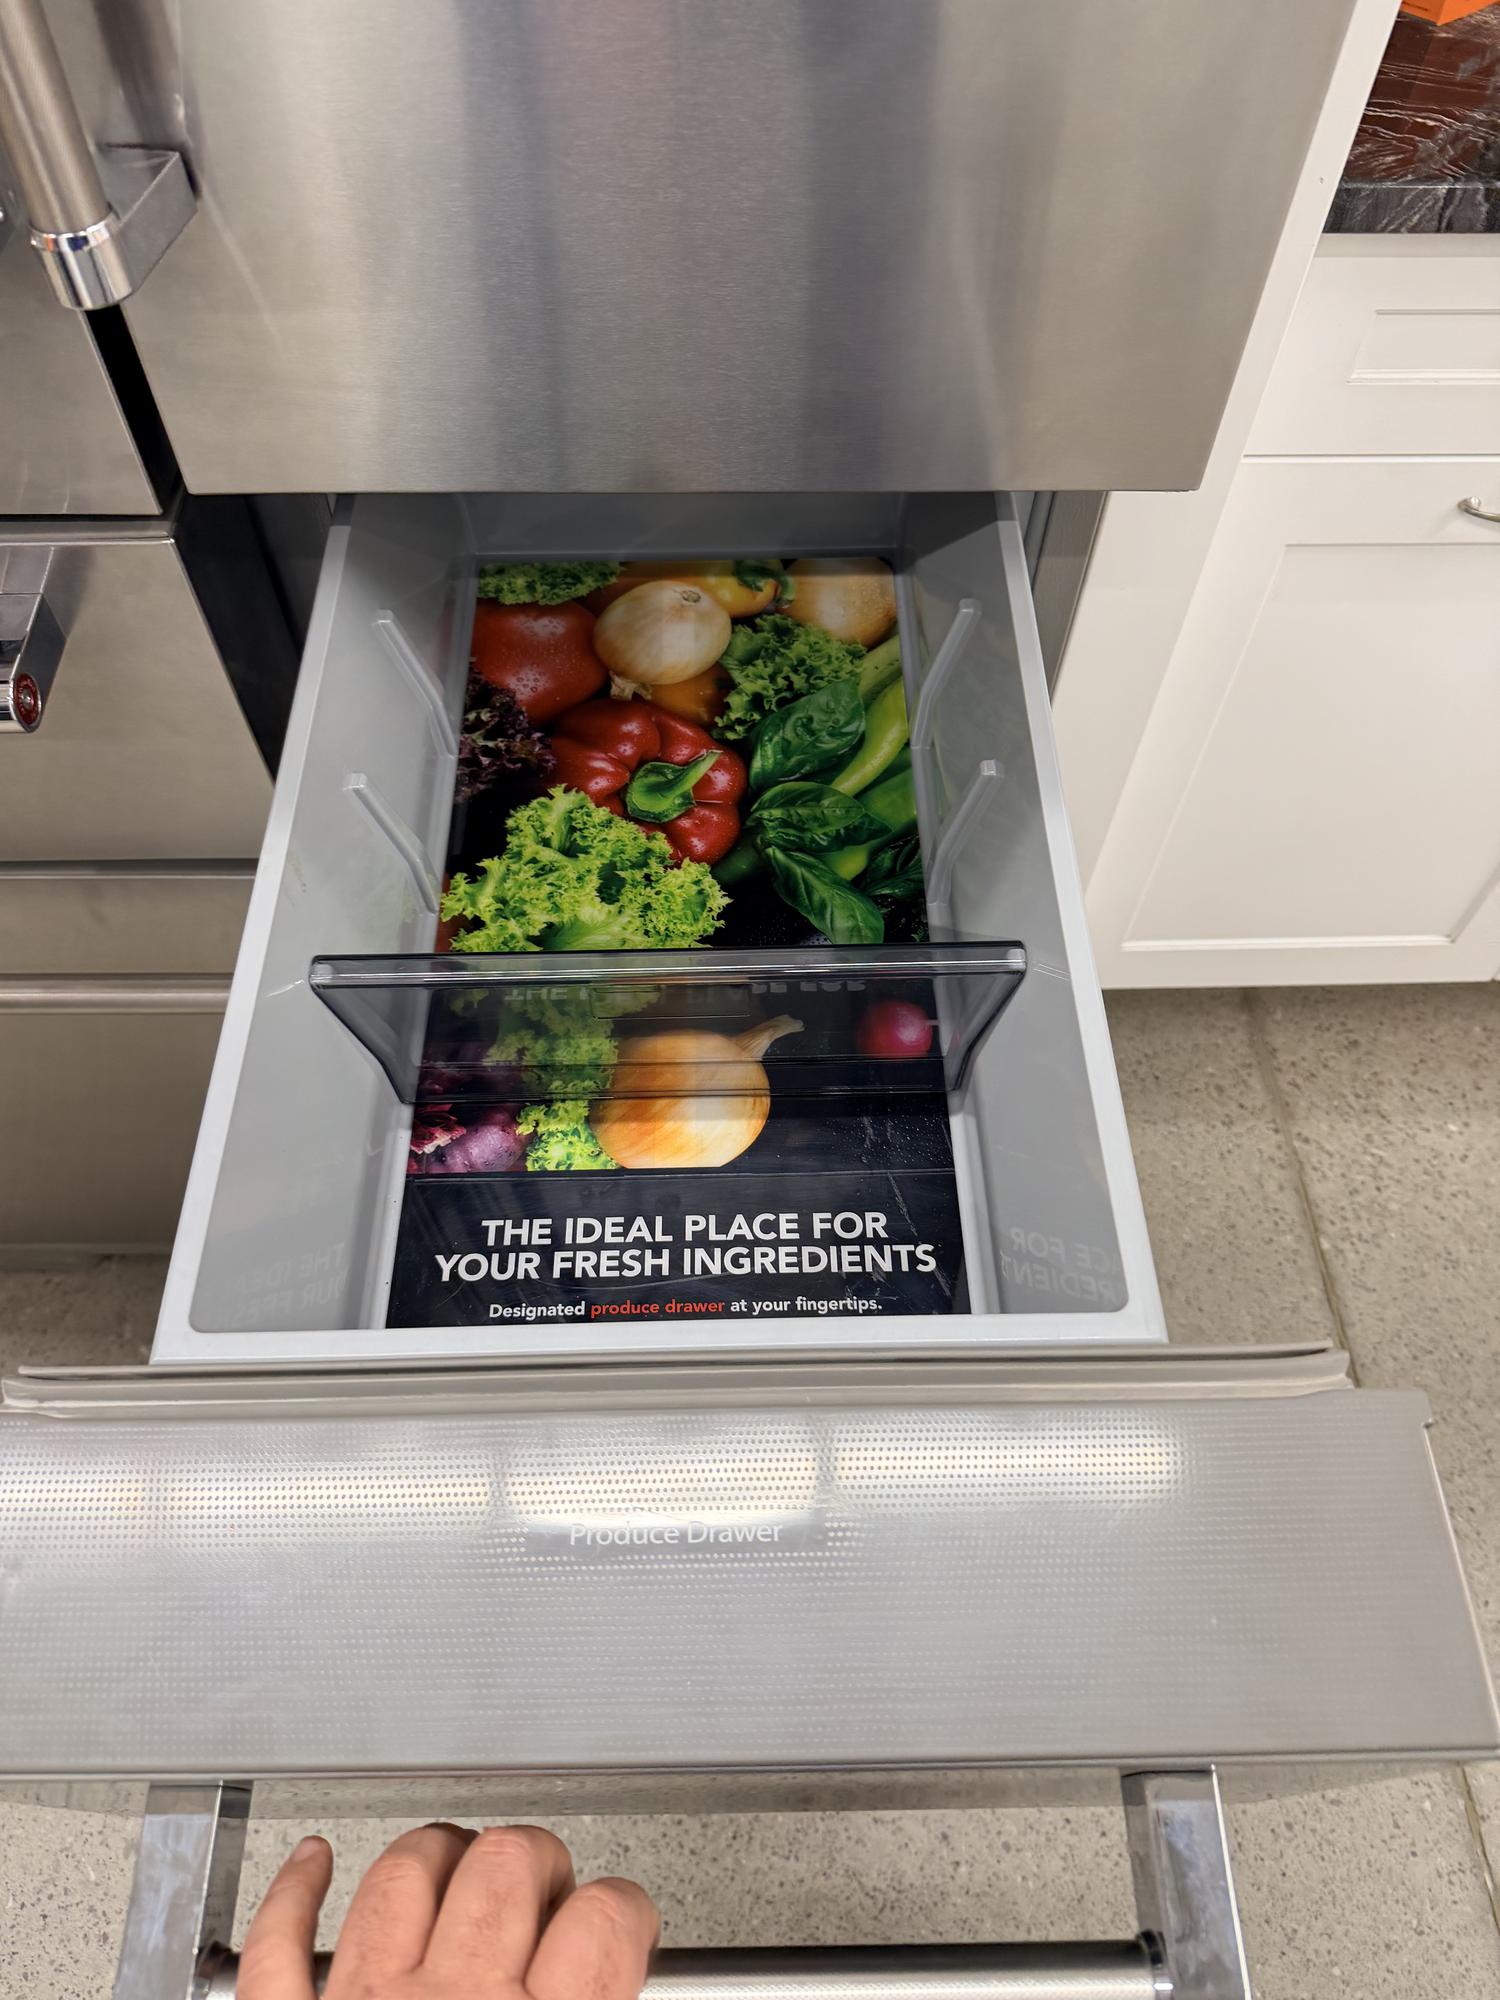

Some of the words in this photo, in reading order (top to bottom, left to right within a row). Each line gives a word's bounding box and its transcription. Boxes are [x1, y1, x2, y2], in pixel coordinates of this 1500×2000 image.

[482, 1218, 553, 1247] THE
[565, 1216, 674, 1245] IDEAL
[685, 1213, 800, 1242] PLACE
[813, 1211, 889, 1239] FOR
[435, 1252, 541, 1282] YOUR
[552, 1249, 670, 1279] FRESH
[683, 1243, 937, 1277] INGREDIENTS
[489, 1301, 586, 1321] Designated
[590, 1300, 660, 1320] produce
[664, 1299, 726, 1314] drawer
[730, 1299, 748, 1313] at
[751, 1300, 791, 1316] your
[794, 1296, 883, 1315] fingertips.
[569, 1521, 680, 1546] Produce
[687, 1520, 784, 1544] Drawer
